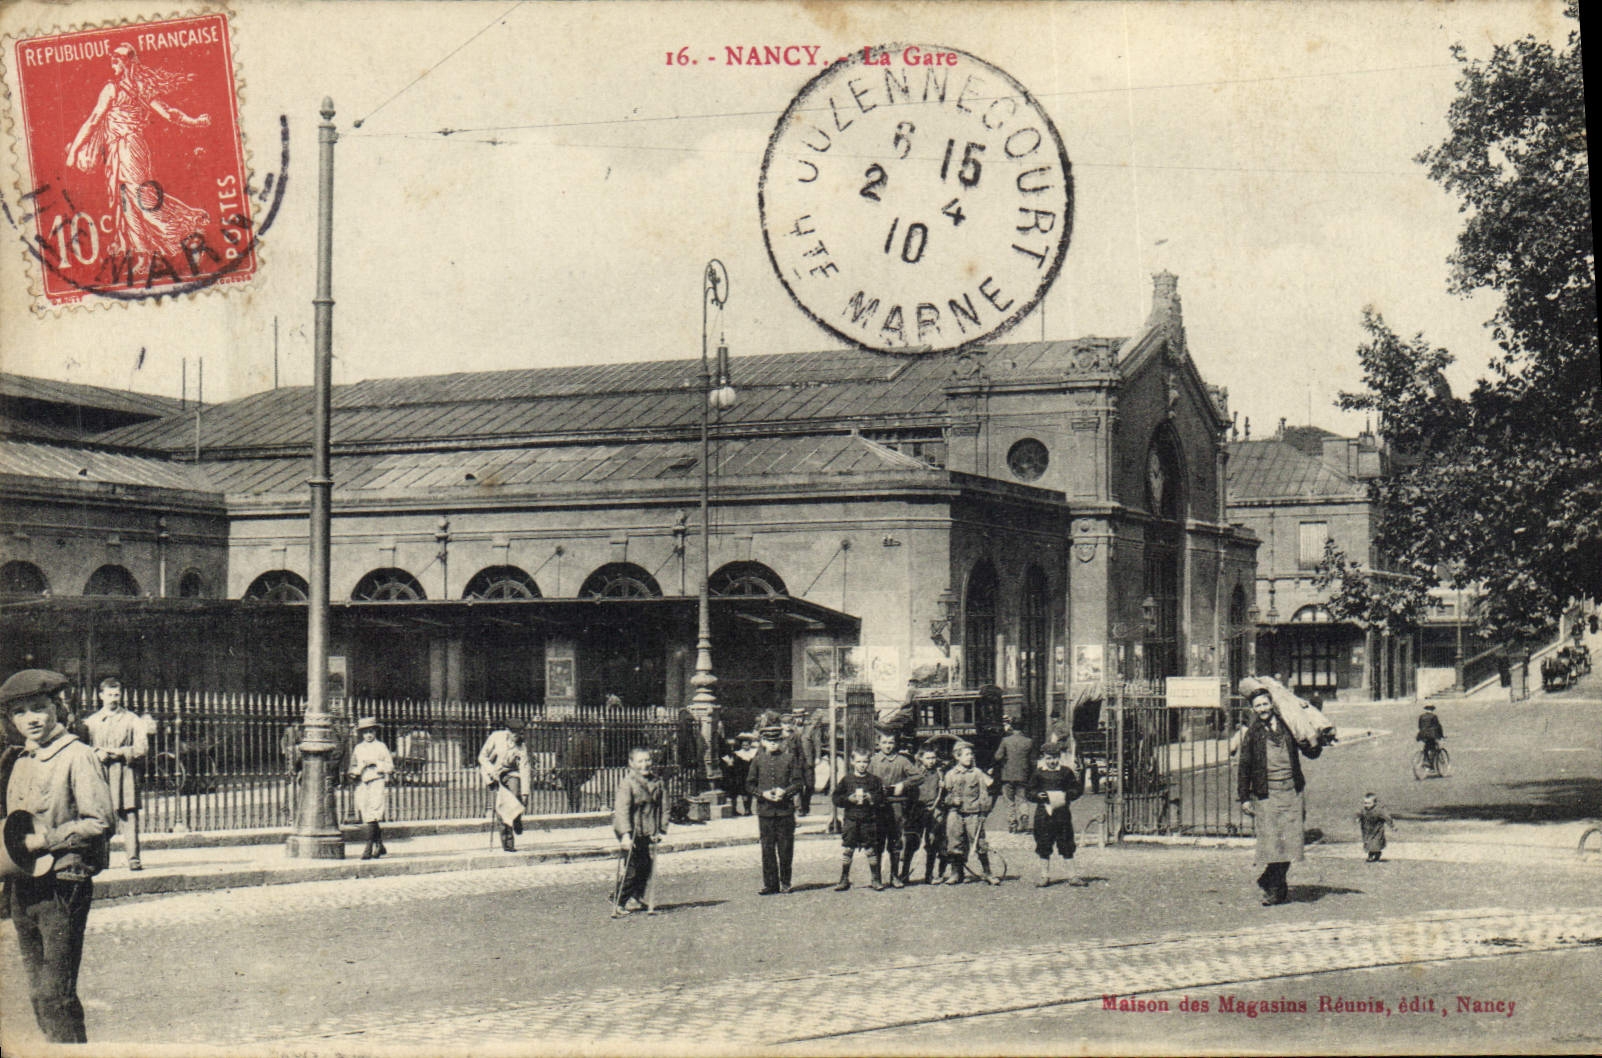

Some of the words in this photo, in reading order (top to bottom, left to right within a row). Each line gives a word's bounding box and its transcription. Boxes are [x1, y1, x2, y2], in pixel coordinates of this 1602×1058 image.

[137, 25, 219, 51] FRANÇAISE
[217, 174, 242, 260] POSTES
[859, 163, 888, 201] 2
[941, 197, 966, 226] 4
[884, 217, 928, 263] 10
[842, 276, 1014, 347] MARNE
